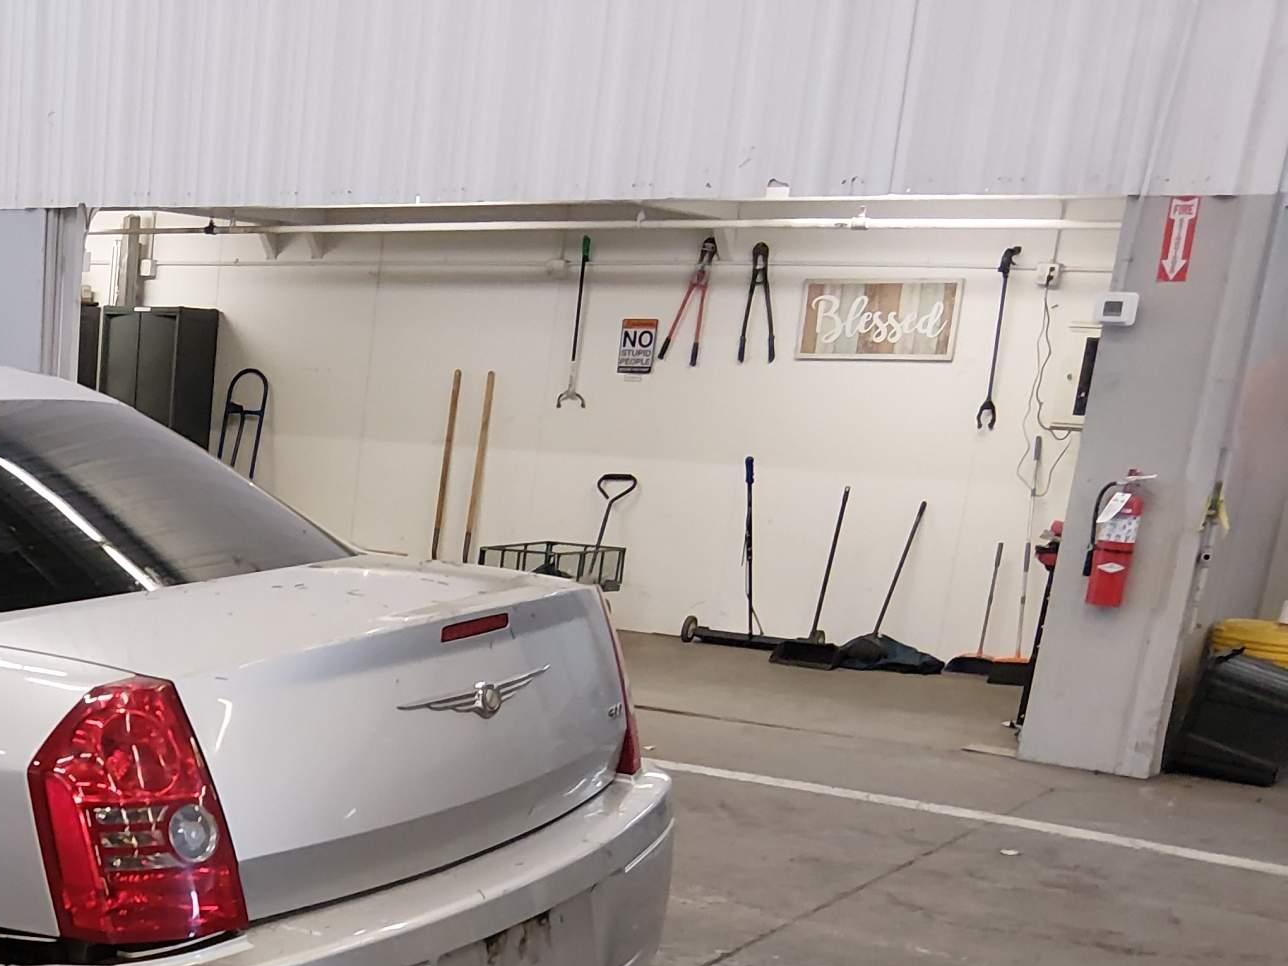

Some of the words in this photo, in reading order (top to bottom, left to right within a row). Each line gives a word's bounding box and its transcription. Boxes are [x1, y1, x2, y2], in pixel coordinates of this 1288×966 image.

[1173, 203, 1195, 215] FIRE
[812, 294, 948, 343] Blessed
[623, 330, 653, 348] NO
[621, 349, 651, 357] STUPID
[618, 358, 649, 366] PEOPLE
